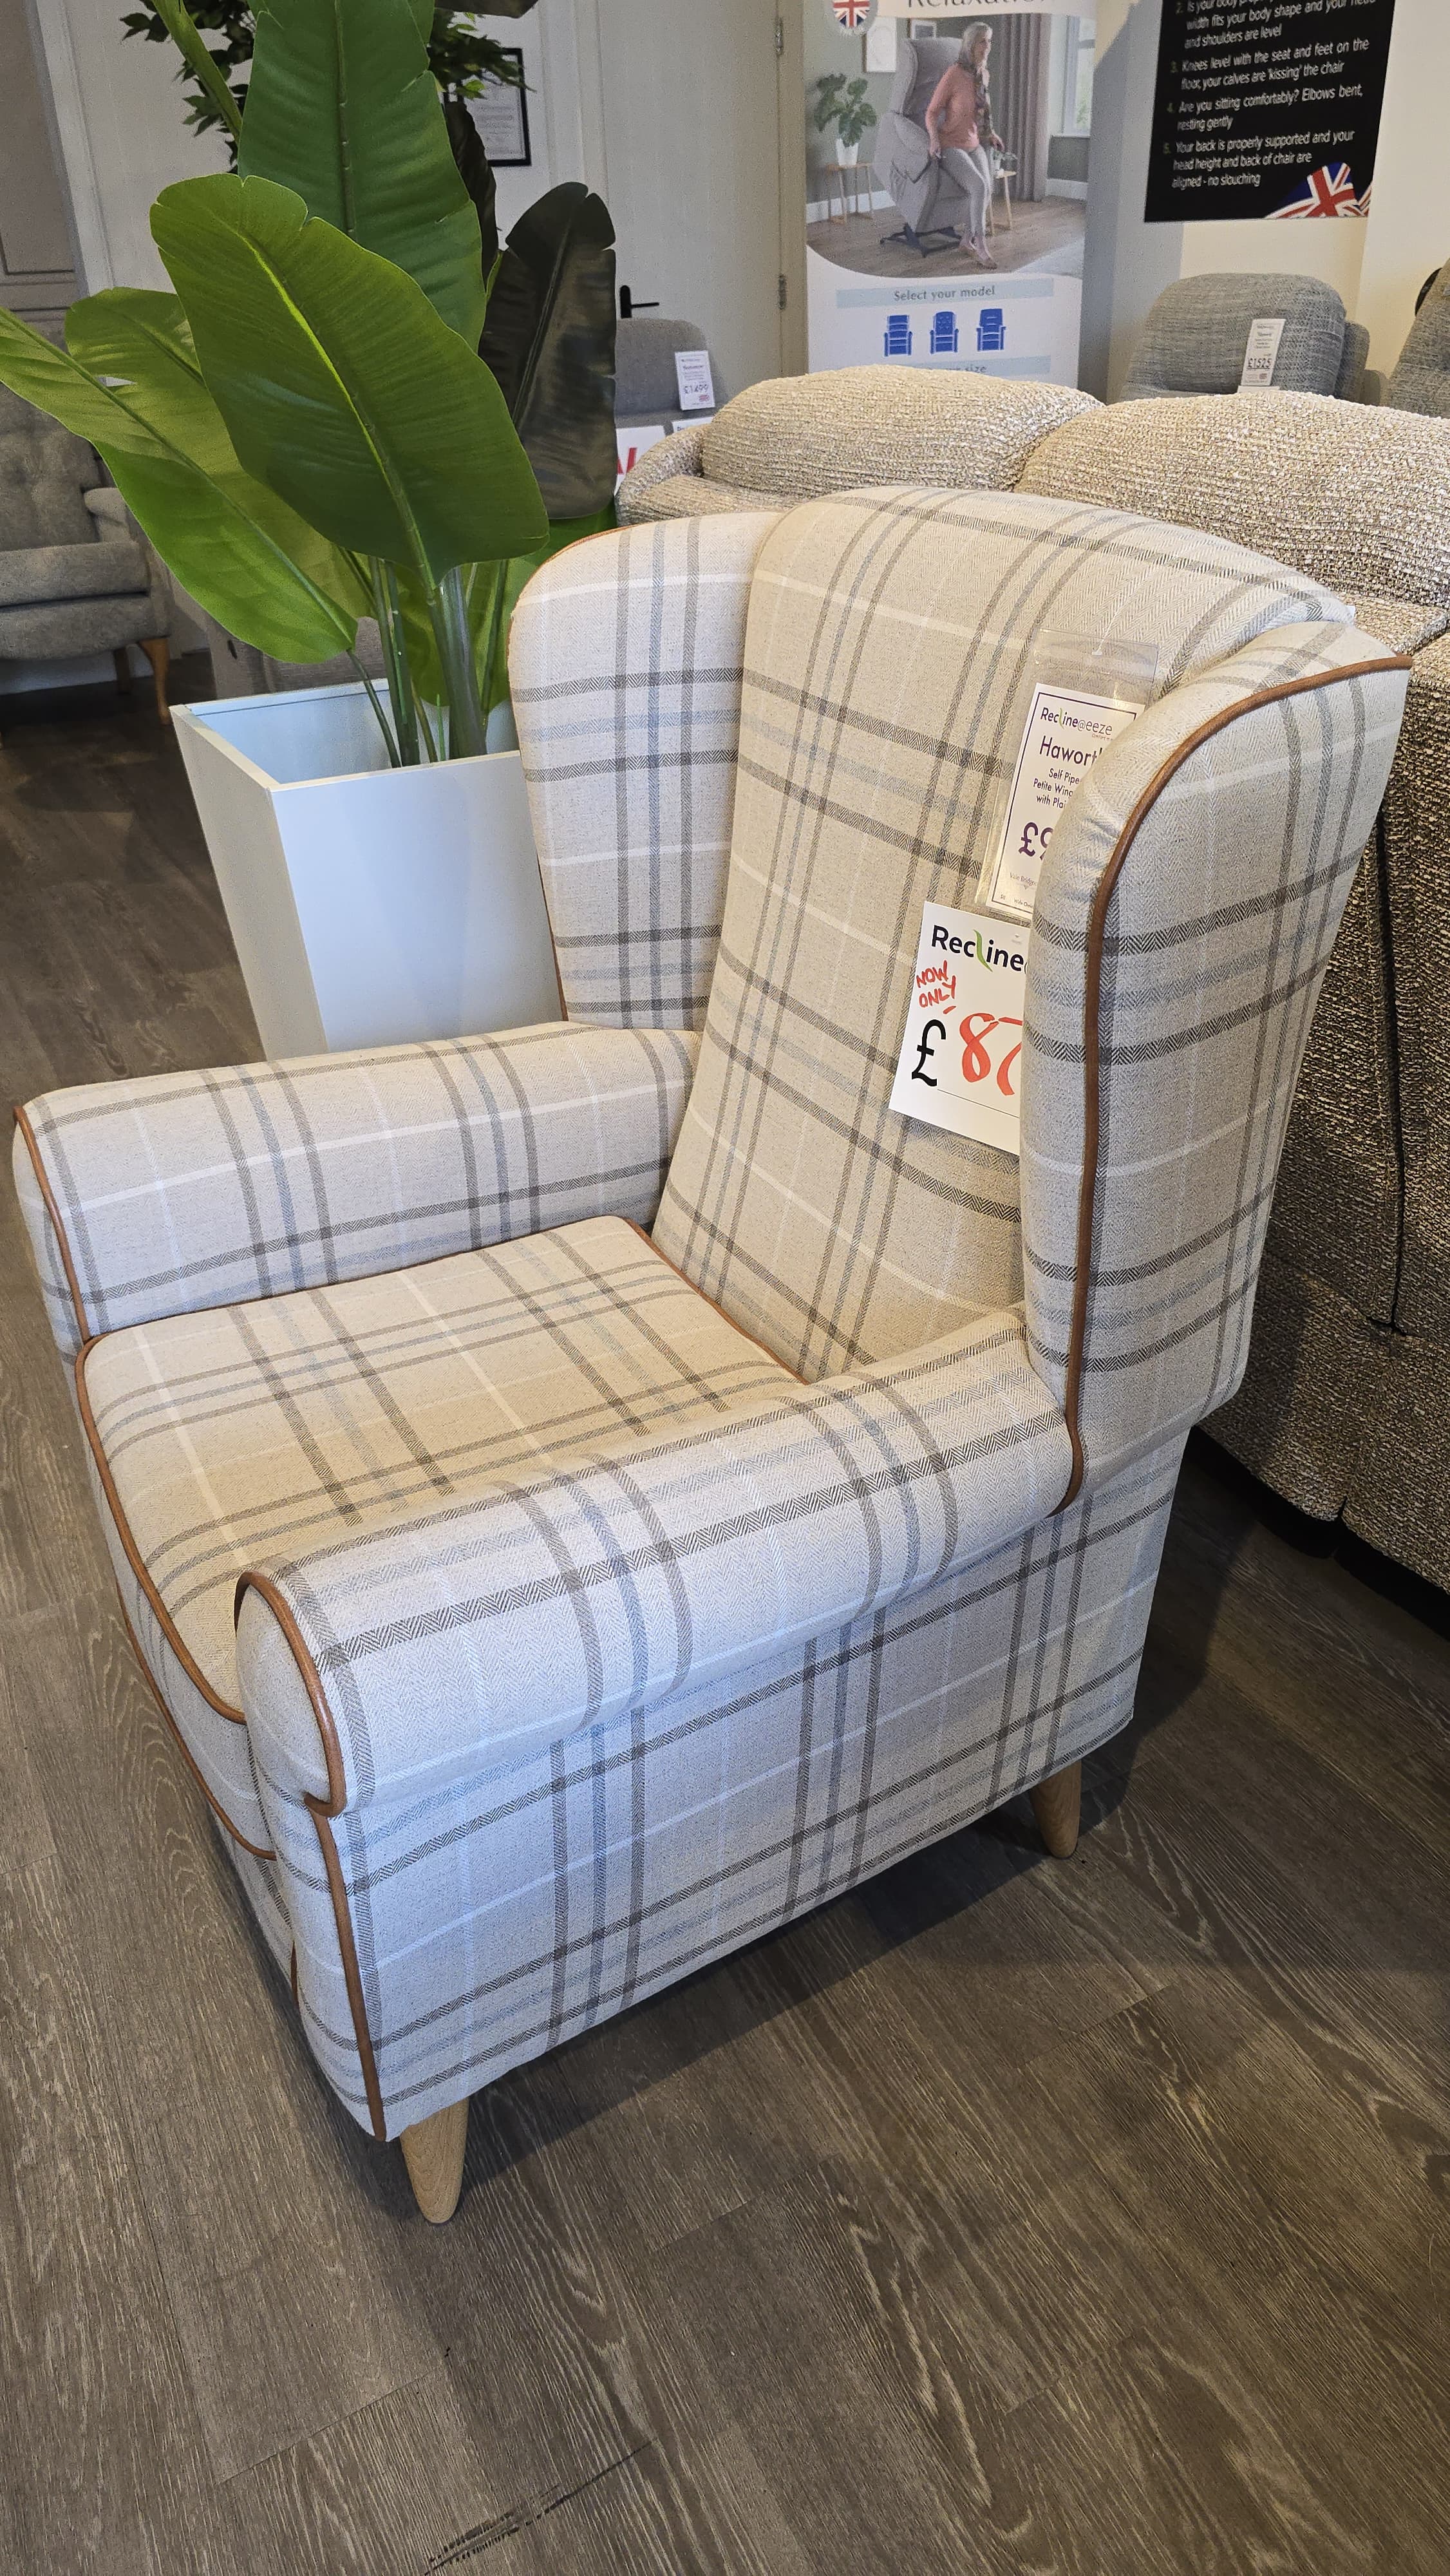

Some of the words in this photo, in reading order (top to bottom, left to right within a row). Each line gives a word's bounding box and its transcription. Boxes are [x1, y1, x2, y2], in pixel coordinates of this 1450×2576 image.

[1187, 1, 1195, 12] Is
[1187, 17, 1209, 30] width
[1212, 14, 1225, 26] fits
[1227, 13, 1247, 28] your
[1249, 6, 1272, 23] body
[1274, 4, 1302, 18] shape
[1304, 1, 1323, 13] and
[1326, 0, 1346, 14] your
[1184, 36, 1201, 49] and
[1201, 31, 1243, 46] shoulders
[1245, 30, 1259, 41] are
[1261, 23, 1282, 39] level
[1182, 60, 1208, 71] Knees
[1210, 53, 1231, 69] level
[1234, 52, 1252, 65] with
[1254, 50, 1269, 64] the
[1272, 47, 1291, 62] seat
[1294, 43, 1312, 59] and
[1315, 41, 1333, 56] feet
[1337, 41, 1350, 53] on
[1353, 37, 1370, 52] the
[1202, 77, 1221, 91] your
[1223, 73, 1250, 86] calves
[1251, 71, 1266, 83] are
[1303, 63, 1319, 77] the
[1321, 59, 1344, 75] chair
[1178, 101, 1194, 113] Are
[1196, 101, 1212, 115] you
[1215, 97, 1241, 111] sitting
[1243, 88, 1299, 108] comfortably?
[1302, 87, 1335, 102] Elbows
[1339, 84, 1363, 97] bent,
[1178, 118, 1205, 132] resting
[1207, 114, 1234, 131] gently
[1176, 141, 1194, 153] Your
[1196, 139, 1216, 152] back
[1218, 138, 1225, 150] is
[1227, 135, 1263, 153] properly
[1265, 131, 1311, 149] supported
[1312, 129, 1331, 144] and
[1332, 130, 1355, 145] your
[1173, 158, 1194, 170] head
[1195, 155, 1221, 172] height
[1222, 154, 1239, 168] and
[1240, 153, 1262, 167] back
[1263, 152, 1273, 166] of
[1274, 151, 1295, 165] chair
[1296, 152, 1312, 163] are
[1171, 175, 1202, 191] aligned
[1208, 176, 1219, 186] no
[1220, 172, 1261, 187] slouching
[894, 290, 927, 301] Select
[931, 290, 956, 301] your
[960, 285, 995, 297] model
[965, 364, 987, 373] size
[1033, 778, 1051, 791] Petite
[1049, 768, 1063, 780] Self
[1064, 772, 1082, 786] Pipe
[1037, 794, 1050, 806] with
[1053, 797, 1067, 810] Plai
[1018, 822, 1054, 860] £9
[932, 925, 1028, 974] Recline
[916, 960, 948, 988] NOW
[919, 975, 957, 1008] ONLY
[912, 1012, 1022, 1096] £87
